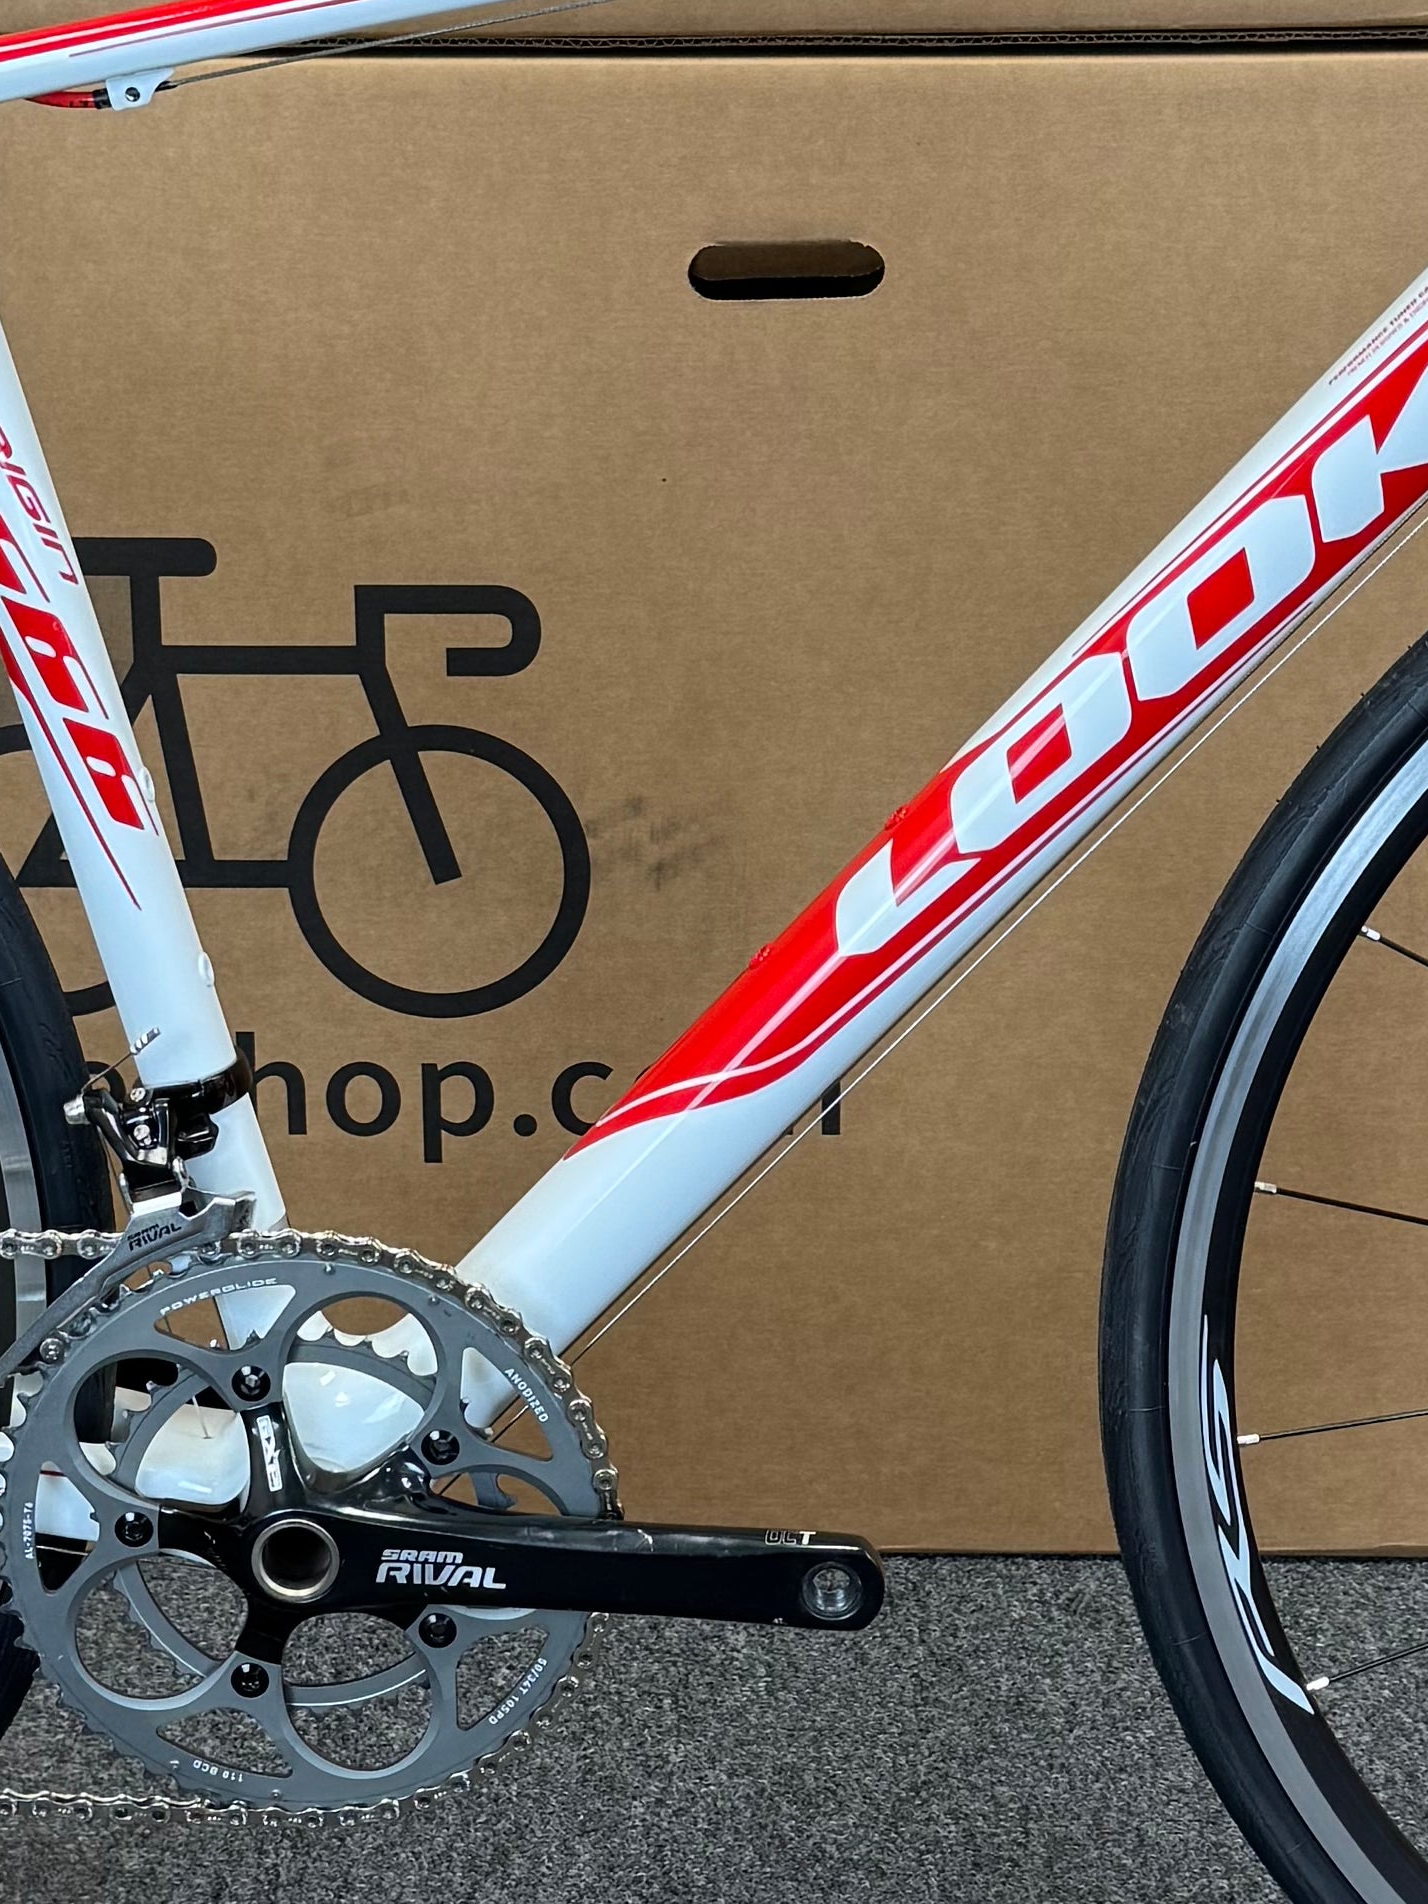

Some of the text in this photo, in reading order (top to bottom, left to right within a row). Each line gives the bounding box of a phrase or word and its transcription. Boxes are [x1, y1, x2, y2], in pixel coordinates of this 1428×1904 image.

[128, 1223, 182, 1251] RIVAL
[159, 1277, 278, 1316] POWERGLIDE
[504, 1368, 549, 1423] ANODIZED
[380, 1548, 464, 1564] SRAM
[375, 1561, 507, 1590] RIVAL
